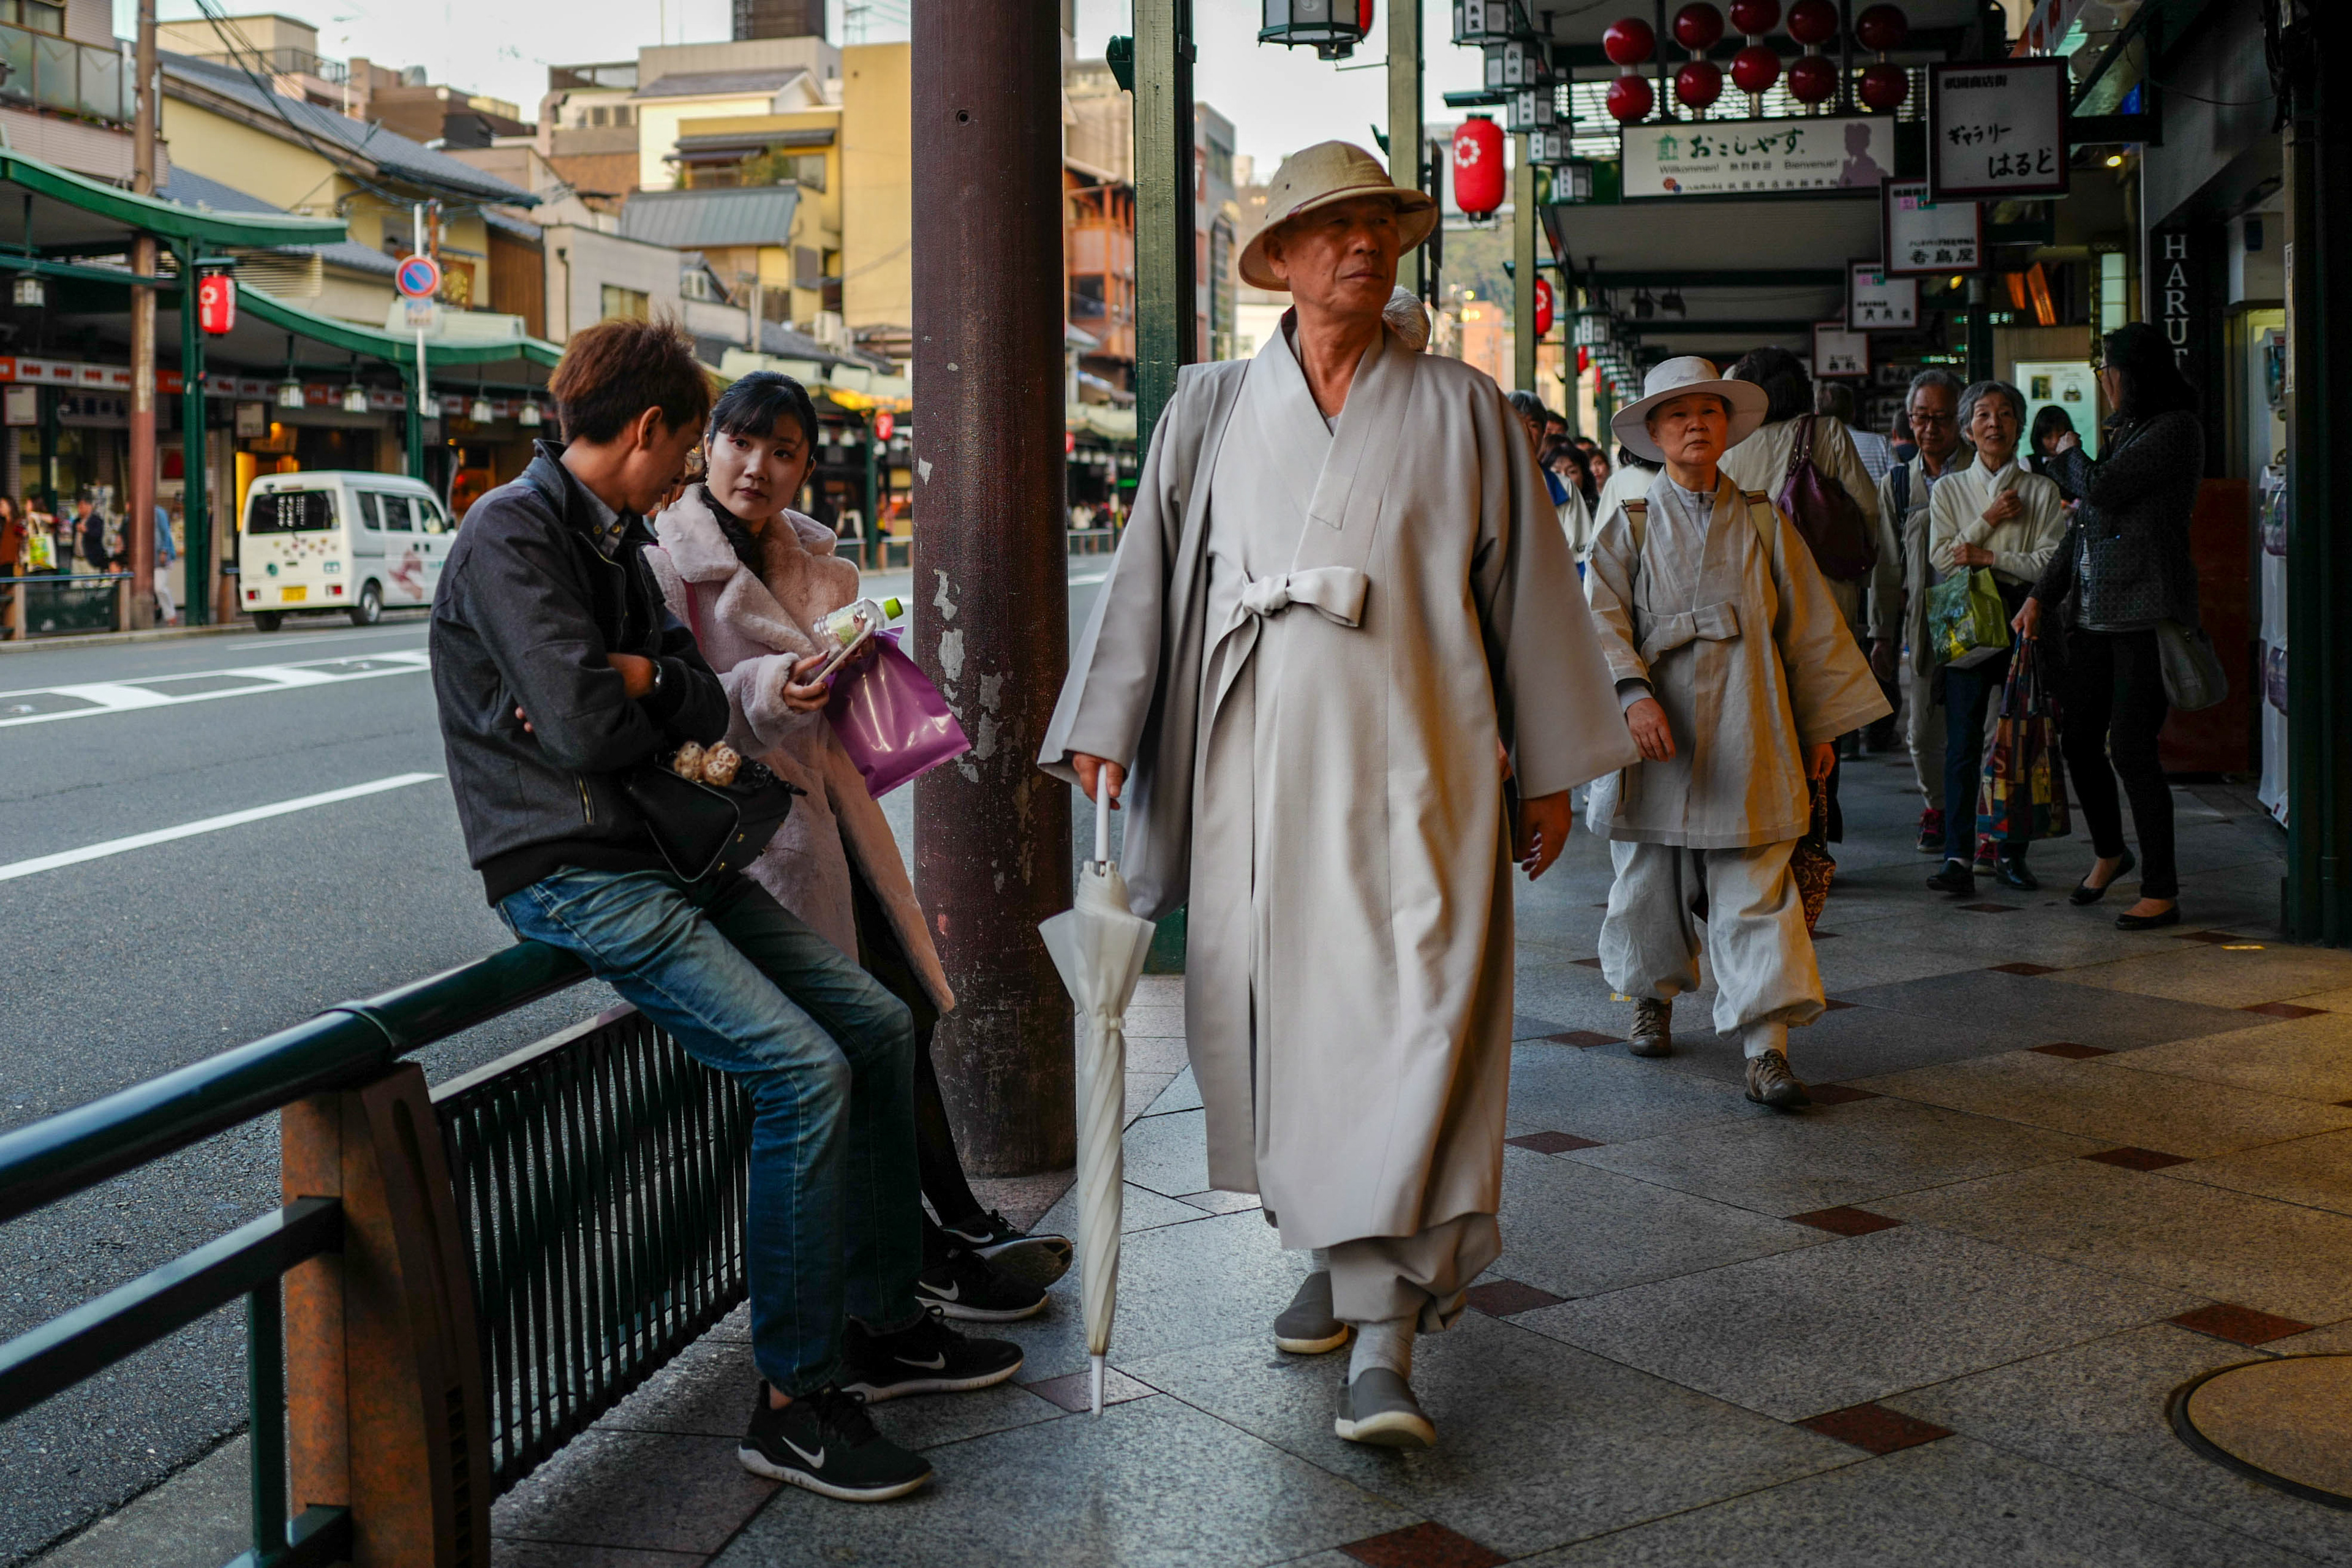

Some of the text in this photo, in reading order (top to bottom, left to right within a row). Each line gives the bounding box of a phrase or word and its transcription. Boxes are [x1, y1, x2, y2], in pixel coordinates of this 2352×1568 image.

[1948, 124, 2012, 146] ギャラリー
[1659, 164, 1719, 174] Willkommen!
[1784, 159, 1838, 170] Bienvenue!
[1988, 148, 2055, 179] はるど
